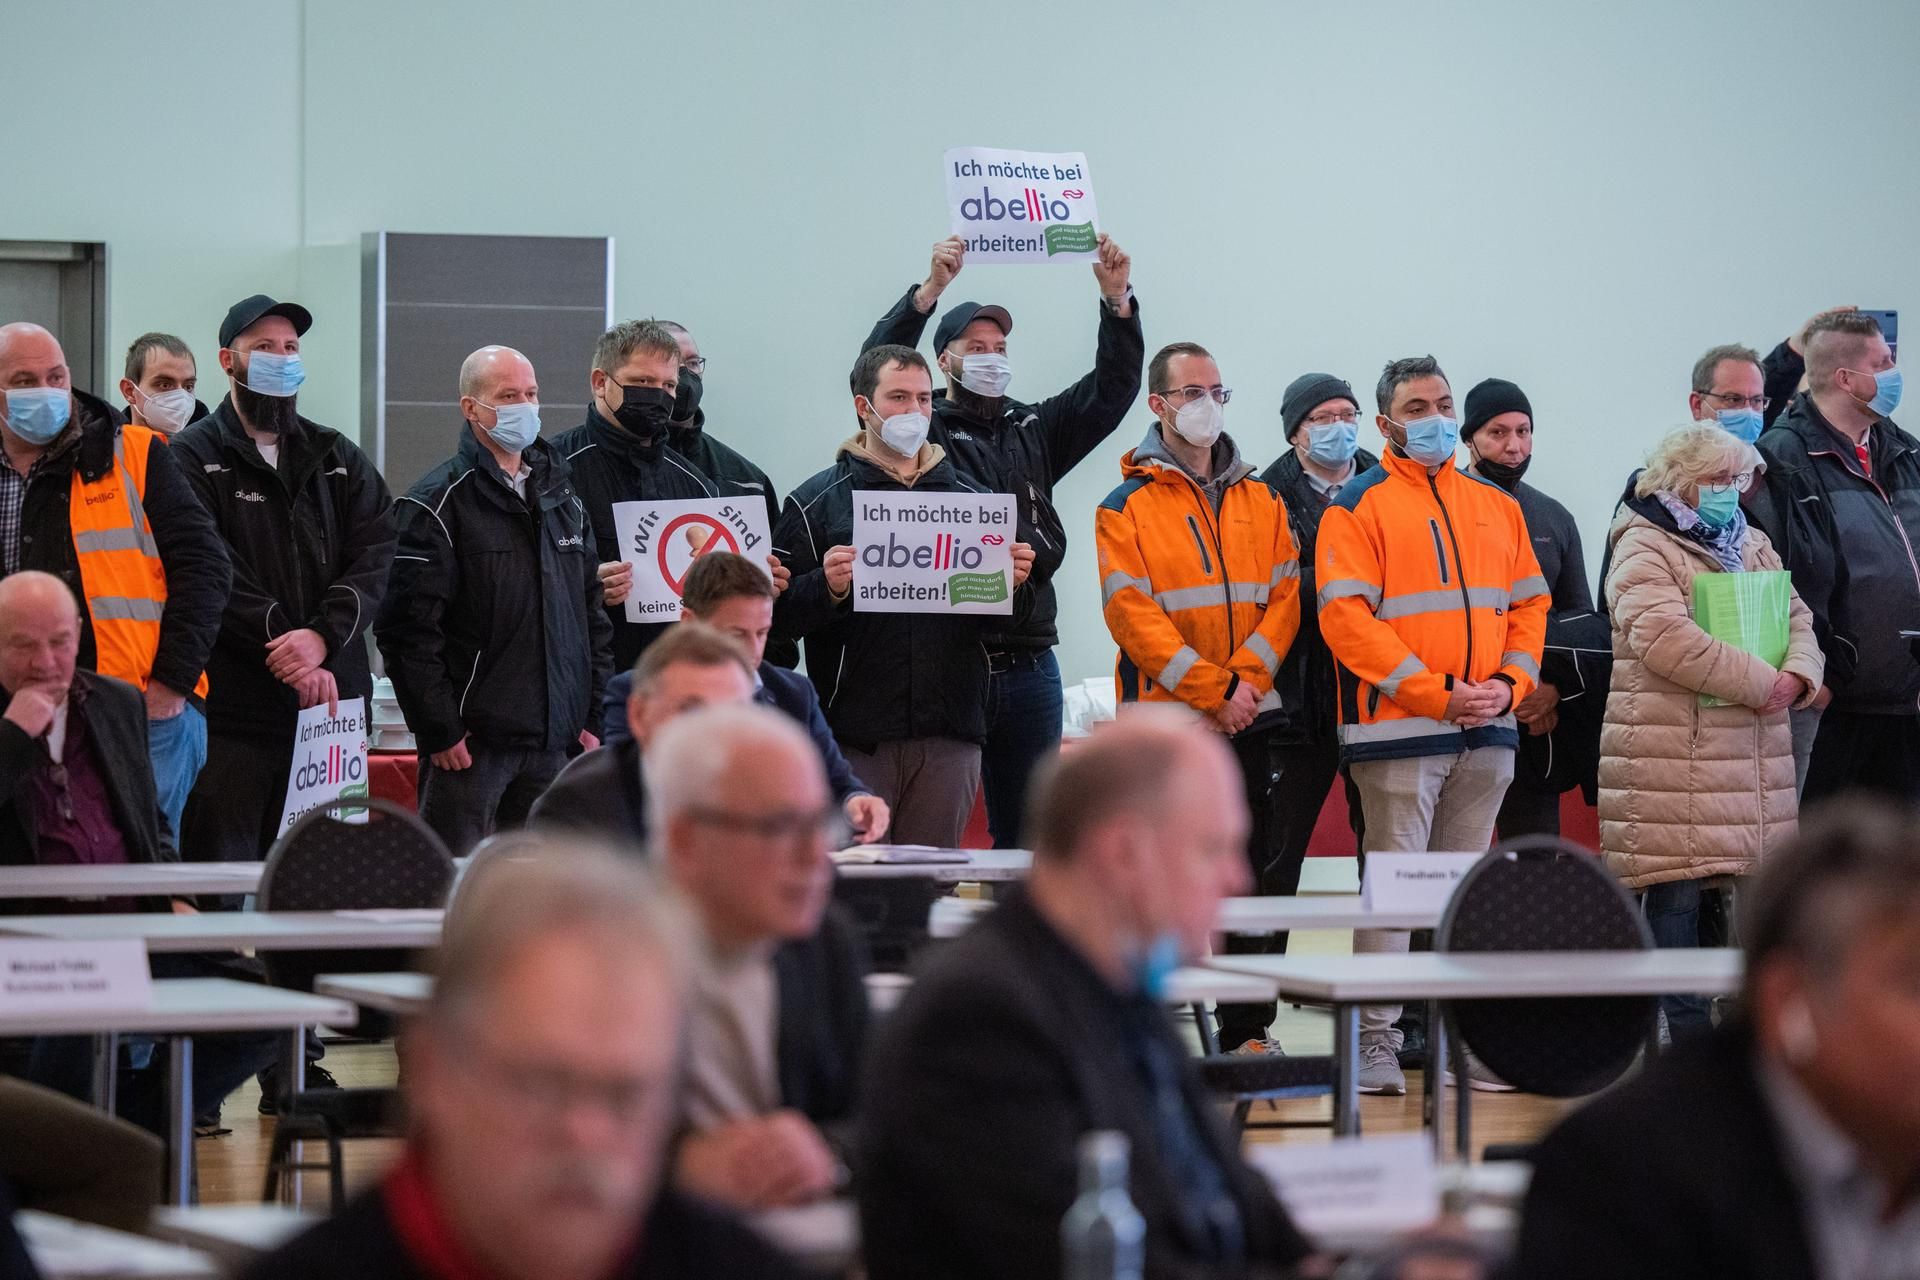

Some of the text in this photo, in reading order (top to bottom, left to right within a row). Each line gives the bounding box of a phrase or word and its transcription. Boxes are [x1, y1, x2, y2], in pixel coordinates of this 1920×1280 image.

[954, 159, 1082, 181] Ich möchte bei
[960, 186, 1070, 222] abellio
[964, 234, 1044, 252] arbeiten!
[235, 487, 266, 502] abellio
[863, 503, 1008, 525] Ich möchte bei
[634, 505, 762, 554] Wir sind
[862, 532, 983, 571] abellio
[860, 581, 947, 601] arbeiten!
[969, 576, 986, 584] nicht
[638, 600, 676, 614] keine
[300, 721, 313, 743] Ich
[313, 715, 356, 739] möchte
[295, 744, 362, 792] abellio
